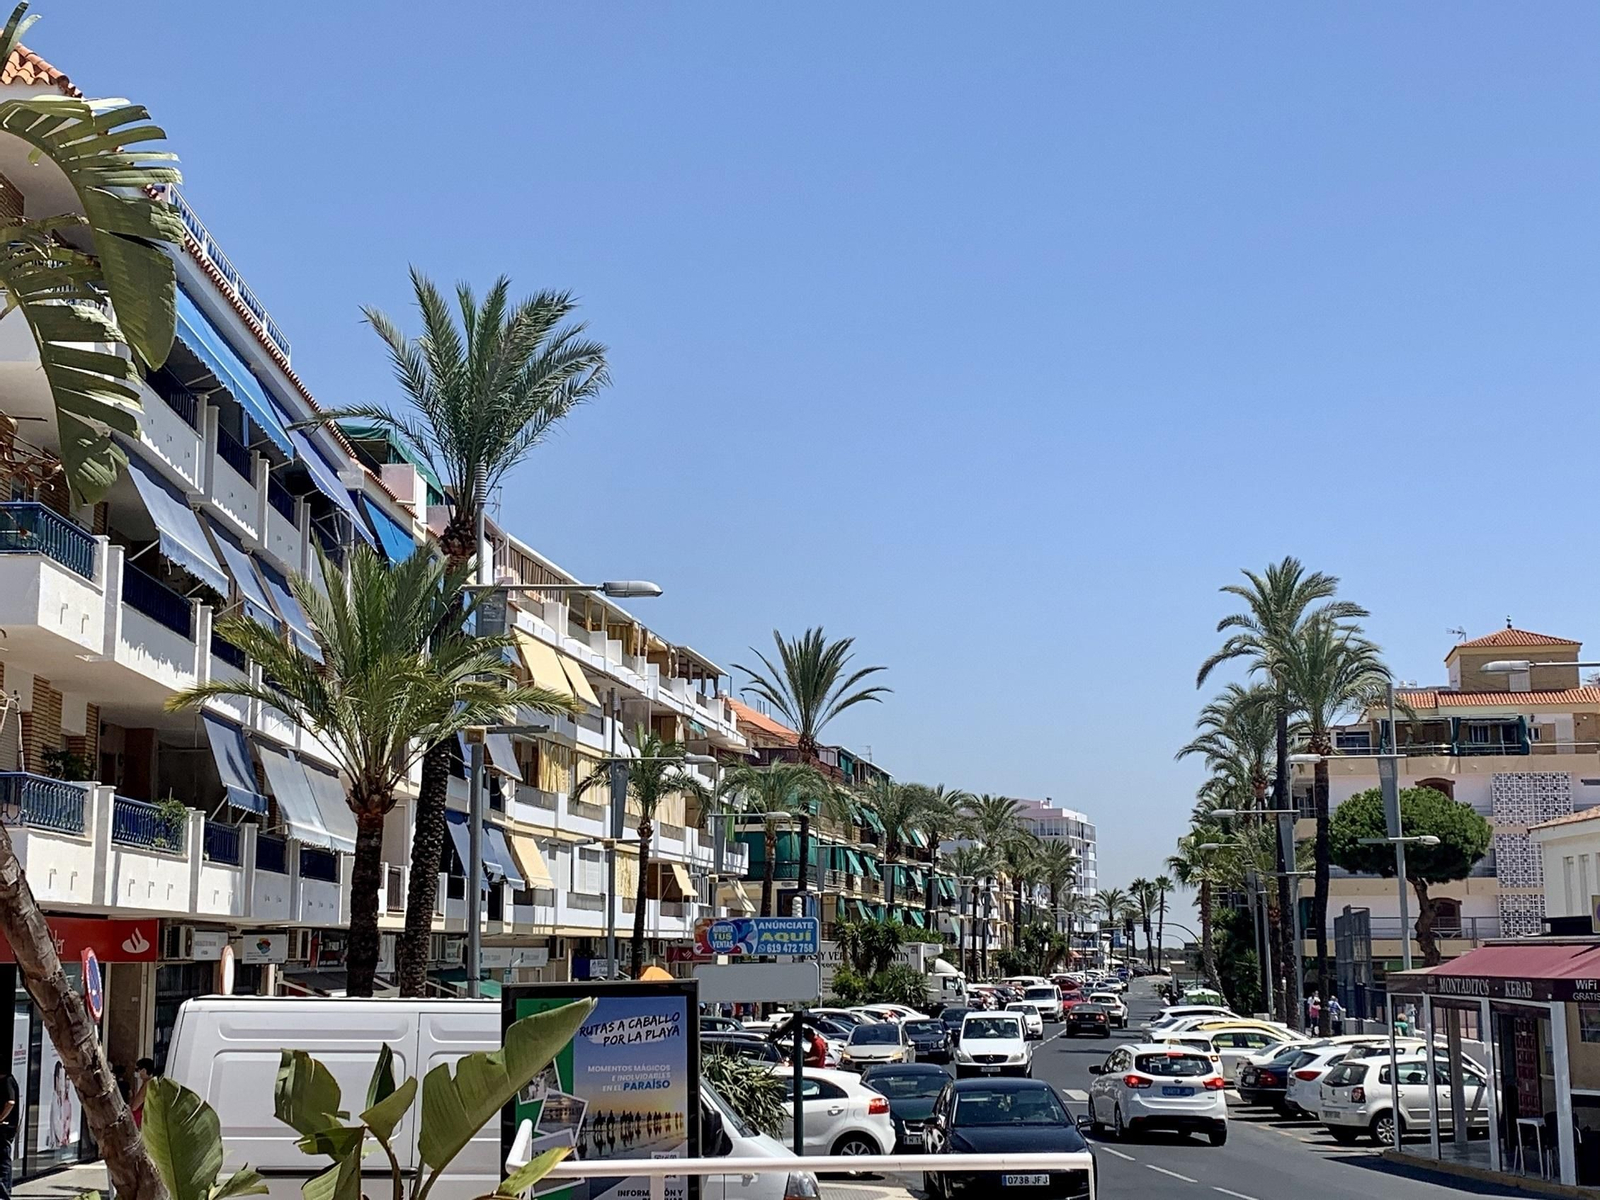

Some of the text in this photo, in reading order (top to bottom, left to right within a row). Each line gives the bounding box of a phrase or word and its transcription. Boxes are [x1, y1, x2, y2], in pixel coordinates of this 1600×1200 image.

[758, 920, 814, 929] ANÚNCIATE
[713, 932, 732, 940] TUS
[760, 930, 812, 943] AQUÍ
[712, 940, 734, 948] VENTAS
[766, 944, 814, 953] 619 472 758
[1439, 977, 1490, 996] MONTADITOS
[1504, 980, 1533, 998] KEBAB
[1575, 979, 1597, 990] WiFi
[579, 1012, 680, 1037] RUTAS A CABALLO
[603, 1025, 680, 1047] POR LA PLAYA
[633, 1063, 671, 1072] MÁGICOS
[623, 1079, 671, 1091] PARAÍSO
[617, 1188, 676, 1197] INFORMÓN
